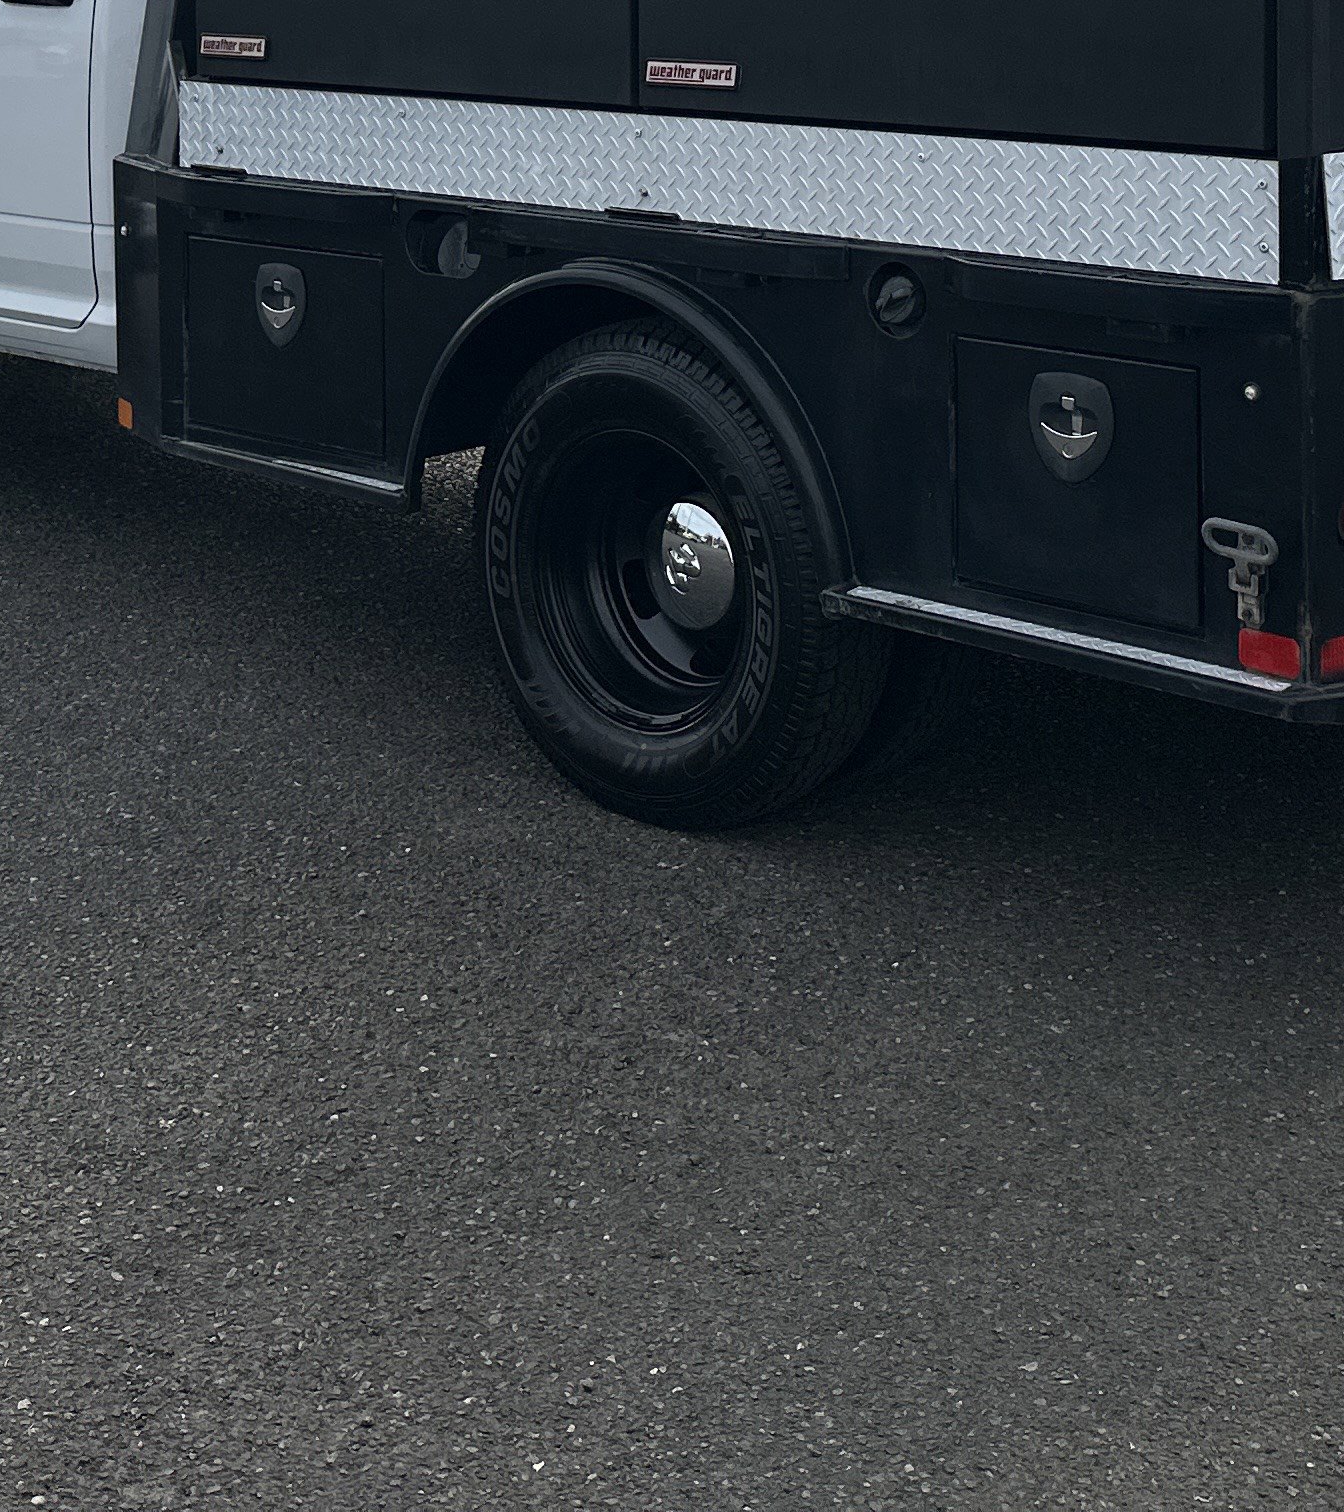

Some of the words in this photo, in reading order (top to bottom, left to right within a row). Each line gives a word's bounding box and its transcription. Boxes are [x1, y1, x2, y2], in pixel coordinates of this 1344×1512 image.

[203, 39, 238, 51] weather
[239, 40, 263, 54] guard
[649, 64, 697, 79] weather
[699, 67, 733, 82] guard
[490, 418, 541, 599] COSMO
[741, 561, 773, 716] TIGRE
